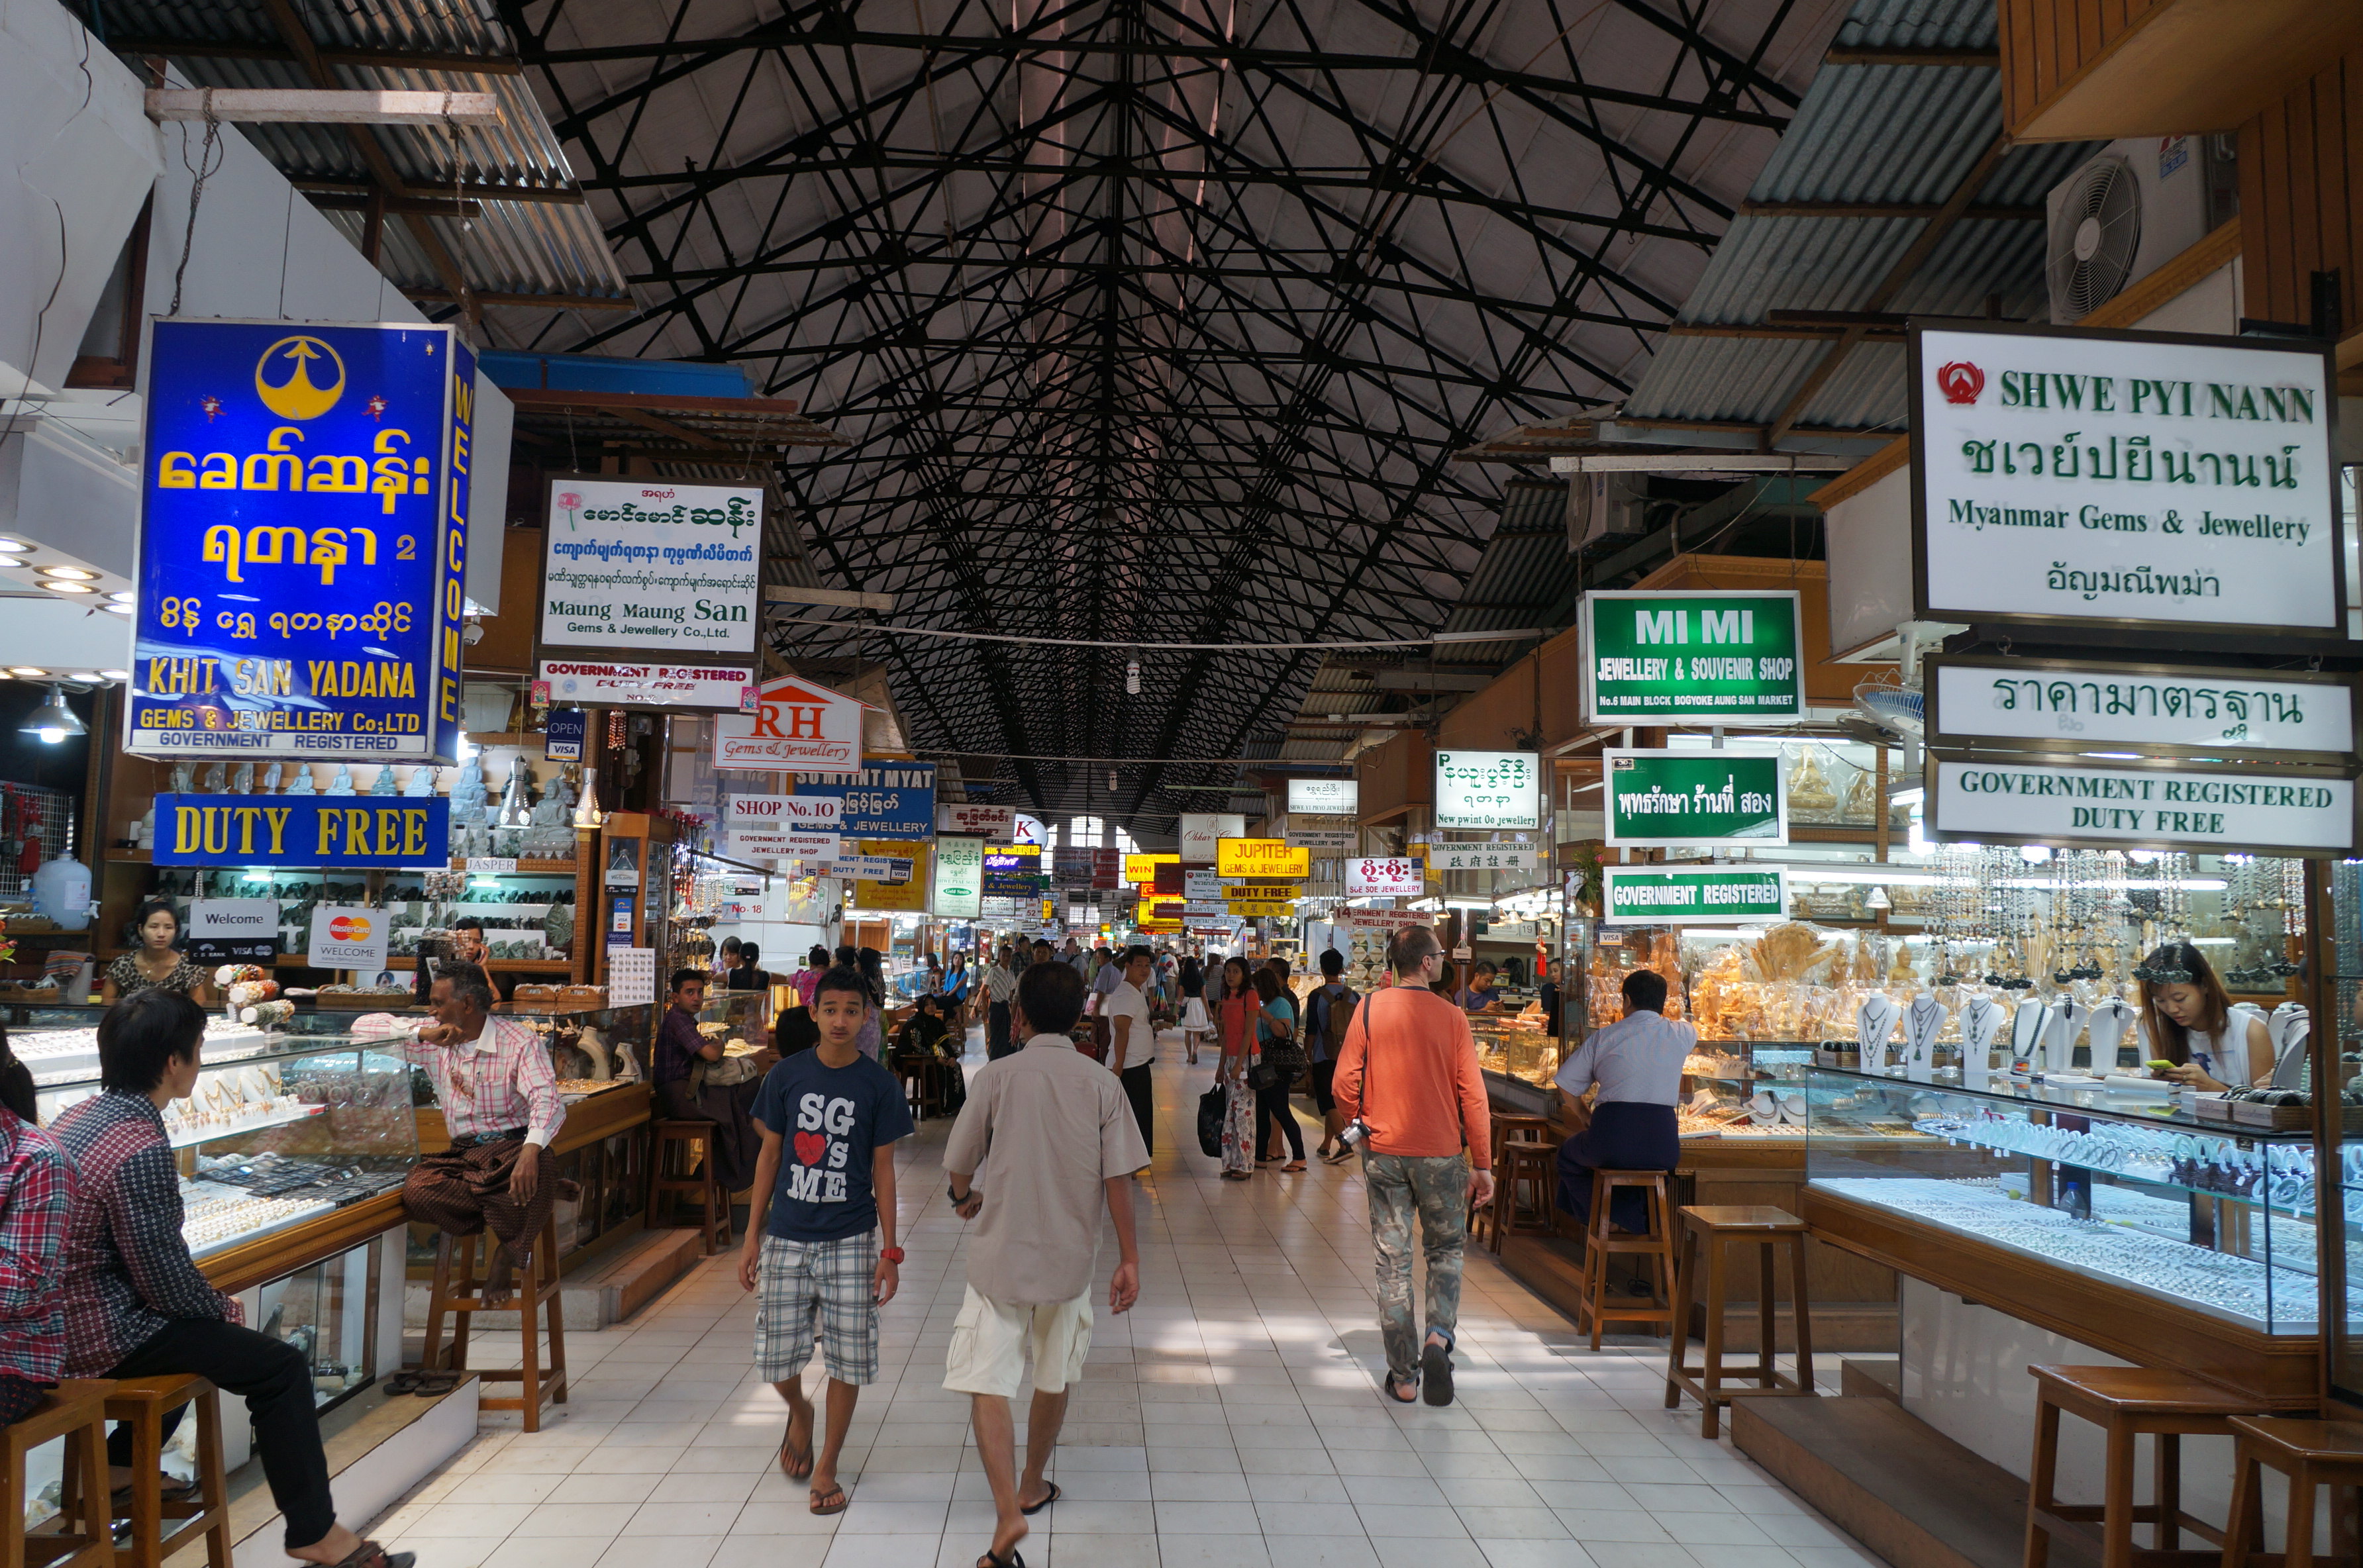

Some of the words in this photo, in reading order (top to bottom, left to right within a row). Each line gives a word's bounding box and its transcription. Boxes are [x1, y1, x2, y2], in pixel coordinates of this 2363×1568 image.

[2000, 369, 2116, 412] SHWE
[2131, 378, 2193, 417] PYI
[2209, 383, 2315, 425] NANN
[1962, 430, 2300, 489] ชเวย์ปยีนานน์
[158, 426, 430, 514] ခေတ်ဆန်း
[642, 489, 675, 503] အရဟံ
[690, 497, 755, 538] ဆန်း
[1948, 498, 2069, 530] Myanmar
[2080, 504, 2148, 532] Gems
[2162, 510, 2184, 534] &
[2199, 511, 2311, 547] Jewellery
[203, 524, 377, 585] ရတနာ
[396, 535, 415, 560] 2
[441, 373, 472, 722] WELCOME
[2047, 562, 2220, 601] อัญมณีพม่า
[160, 597, 202, 636] စိန်
[548, 601, 611, 621] Maung
[623, 604, 685, 623] Maung
[694, 599, 748, 622] San
[567, 622, 603, 634] Gems
[607, 624, 616, 634] &
[621, 624, 678, 638] Jewellery
[683, 626, 730, 638] Co.,Ltd.
[1636, 610, 1688, 644] MI
[1701, 610, 1753, 644] MI
[148, 657, 219, 695] KHIT
[234, 659, 292, 697] SAN
[309, 661, 415, 698] YADANA
[546, 663, 650, 678] GOVERNMENT
[1598, 658, 1668, 681] JEWELLERY
[1675, 658, 1684, 681] &
[1691, 658, 1754, 680] SOUVENIR
[1760, 658, 1793, 680] SHOP
[652, 681, 695, 690] FREE
[1599, 697, 1619, 706] No.6
[1620, 696, 1641, 706] MAIN
[1644, 696, 1671, 706] BLOCK
[1674, 696, 1713, 706] BOGYOKE
[1715, 695, 1737, 705] AUNG
[1738, 695, 1755, 705] SAN
[1758, 695, 1793, 705] MARKET
[1993, 678, 2303, 741] ราคามาตรฐาน
[140, 709, 194, 728] GEMS
[205, 710, 216, 728] &
[226, 710, 344, 731] JEWELLERY
[550, 722, 582, 735] OPEN
[750, 705, 825, 740] RH
[160, 732, 273, 748] GOVERNMENT
[295, 734, 397, 750] REGISTERED
[554, 746, 575, 754] VISA
[725, 741, 762, 758] Gems
[765, 742, 780, 756] &
[782, 744, 850, 760] Jewellery
[823, 768, 881, 788] MYINT
[885, 770, 933, 788] MYAT
[1619, 785, 1689, 820] พุทธรักษา
[1693, 774, 1735, 814] ร้านที่
[1741, 793, 1772, 814] สอง
[1960, 770, 2155, 801] GOVERNMENT
[2166, 779, 2333, 809] REGISTERED
[736, 801, 781, 816] SHOP
[798, 821, 833, 830] GEMS
[840, 821, 847, 830] &
[854, 821, 928, 832] JEWELLERY
[1438, 814, 1456, 823] New
[1458, 814, 1482, 826] pwint
[1485, 815, 1495, 824] Oo
[1497, 815, 1536, 827] jewellery
[2072, 807, 2144, 831] DUTY
[2156, 810, 2225, 834] FREE
[174, 807, 292, 854] DUTY
[315, 808, 428, 856] FREE
[740, 835, 786, 844] GOVERNMENT
[1184, 830, 1211, 842] Okkar
[1235, 844, 1293, 859] JUPITER
[468, 860, 514, 870] JASPER
[1225, 863, 1246, 873] GEMS
[1250, 863, 1256, 873] &
[1258, 864, 1303, 874] JEWELLERY
[998, 883, 1032, 891] Jewellery
[1231, 888, 1258, 897] DUTY
[1264, 888, 1291, 897] FREE
[1613, 885, 1697, 906] GOVERNMENT
[1703, 884, 1779, 905] REGISTERED
[206, 914, 264, 924] Welcome
[1336, 908, 1351, 918] 14
[1352, 918, 1395, 927] JEWELLERY
[1353, 908, 1385, 917] ERNMENT
[1389, 911, 1430, 920] REGISTERED
[330, 924, 371, 934] MasterCard
[321, 947, 376, 957] WELCOME
[797, 1093, 855, 1136] SG
[787, 1163, 847, 1203] ME
